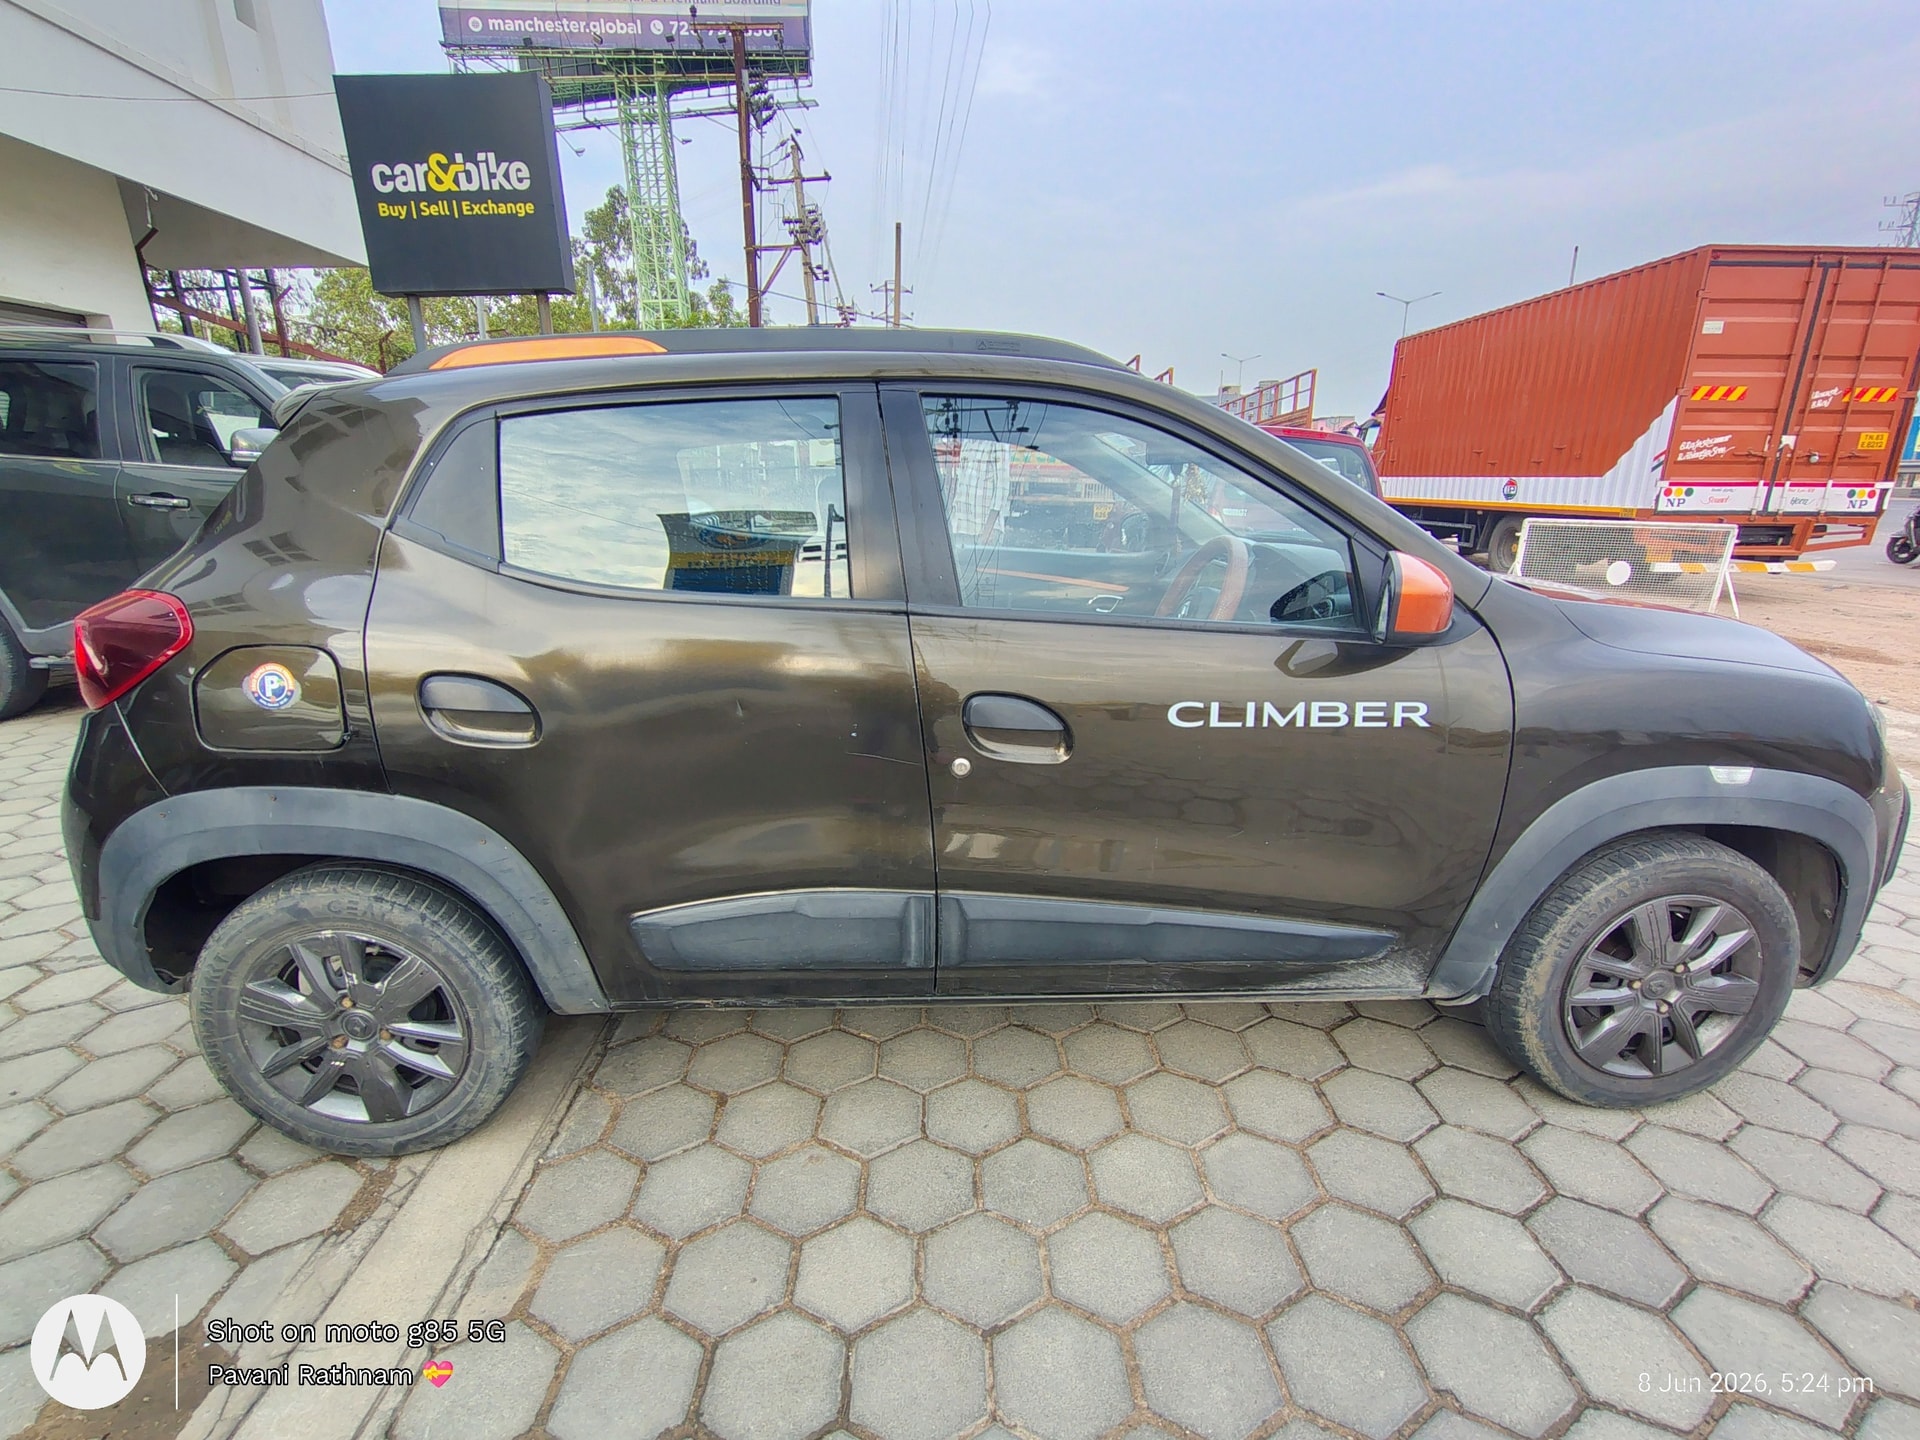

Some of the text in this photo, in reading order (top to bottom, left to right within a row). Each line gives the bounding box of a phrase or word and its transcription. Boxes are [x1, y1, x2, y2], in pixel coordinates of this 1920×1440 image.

[487, 17, 642, 34] manchester.global
[371, 151, 531, 193] car&bike
[377, 200, 534, 219] Buy Sell Exchange
[1167, 701, 1431, 728] CLIMBER
